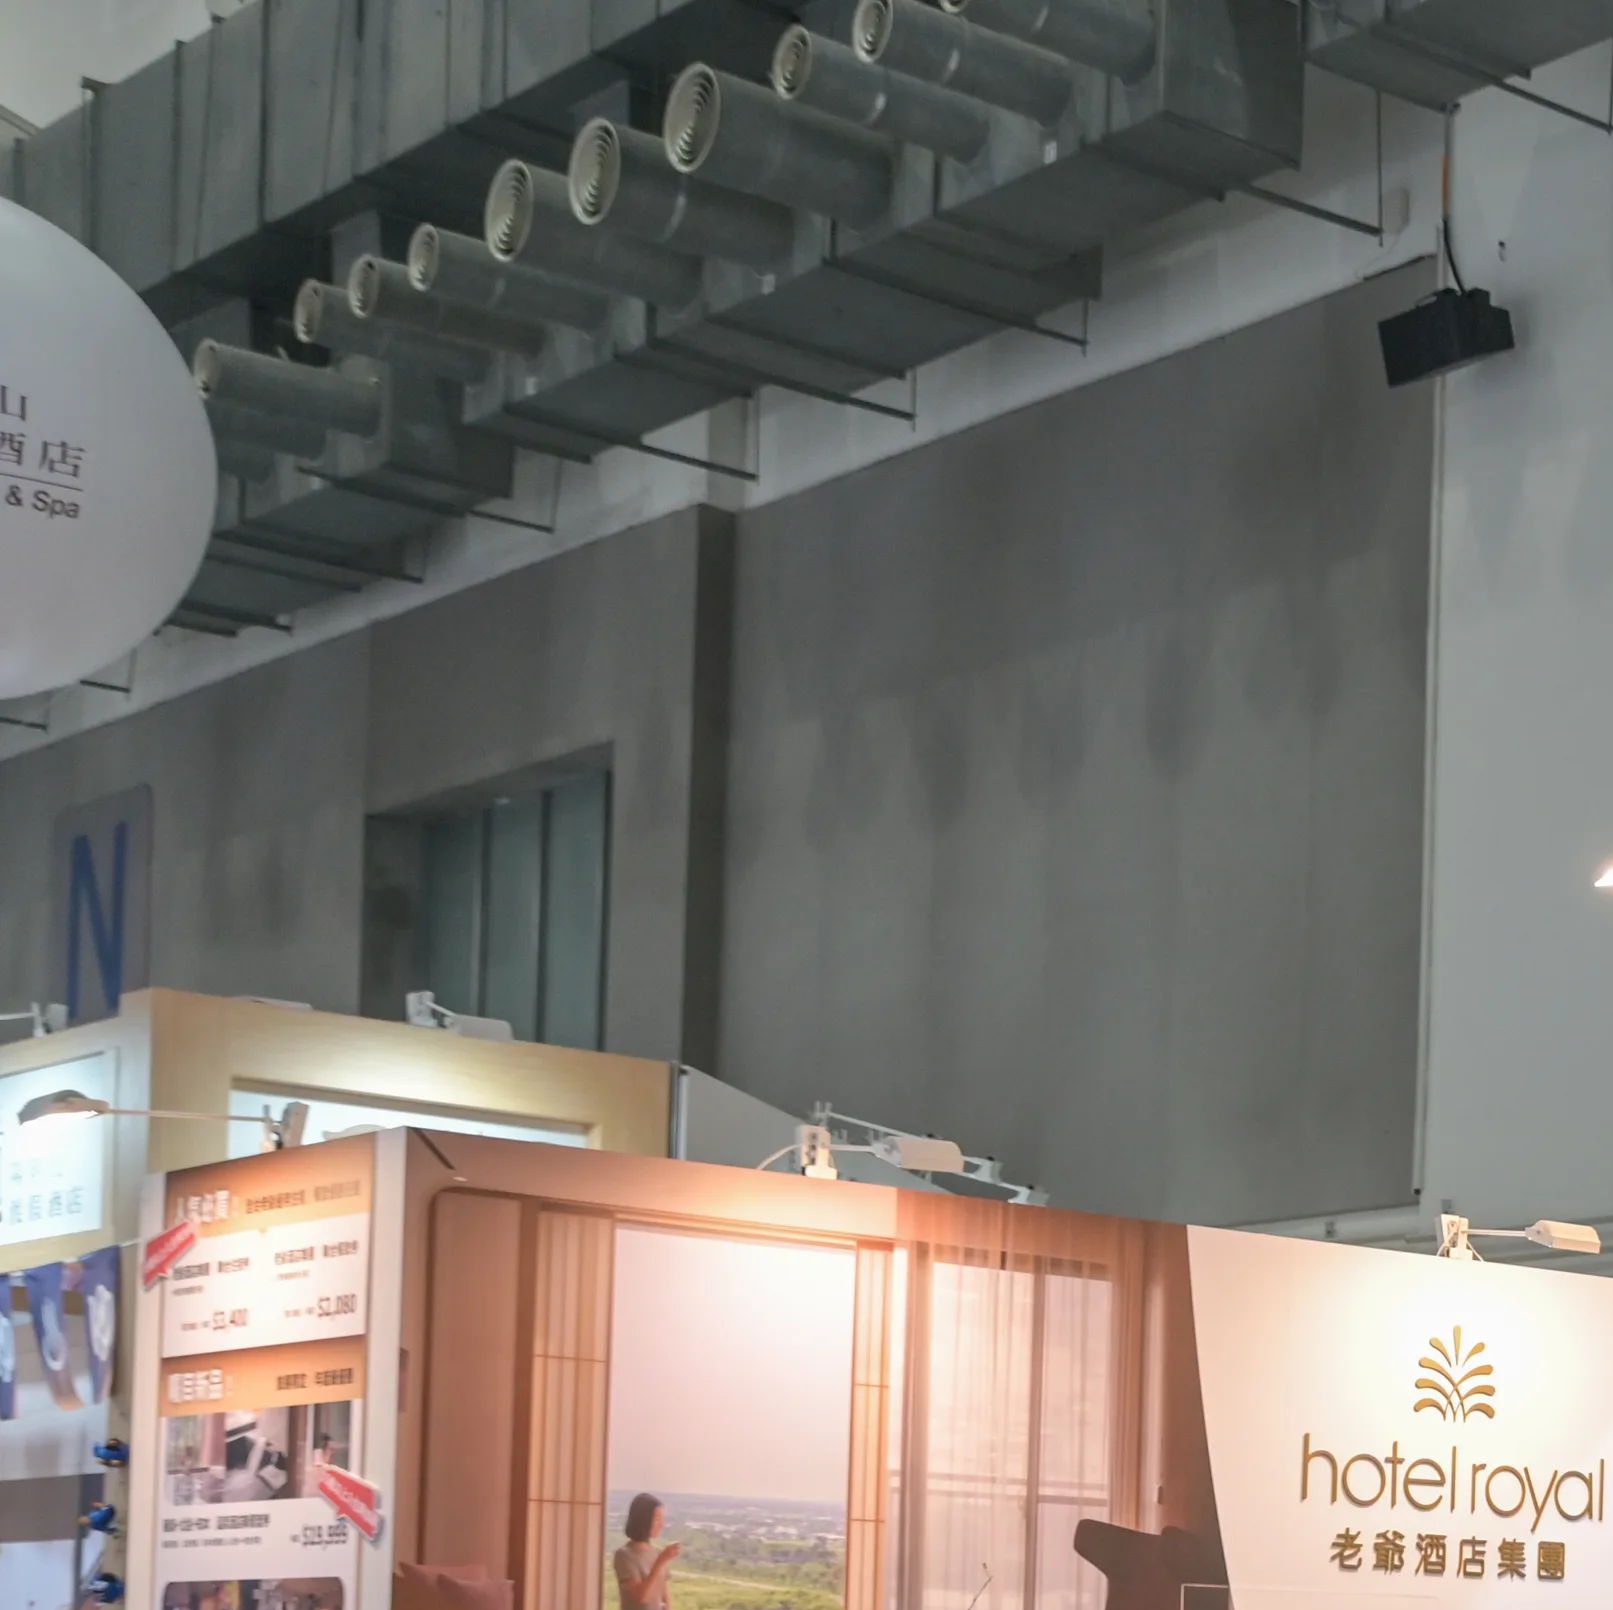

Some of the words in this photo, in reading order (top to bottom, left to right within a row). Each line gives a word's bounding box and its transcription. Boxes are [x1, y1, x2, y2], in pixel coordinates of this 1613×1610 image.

[5, 484, 24, 507] &
[32, 489, 80, 518] Spa
[66, 820, 128, 1021] N
[1301, 1432, 1457, 1513] hotel
[1470, 1458, 1605, 1534] royal
[1330, 1526, 1566, 1581] 老爺酒店集團
